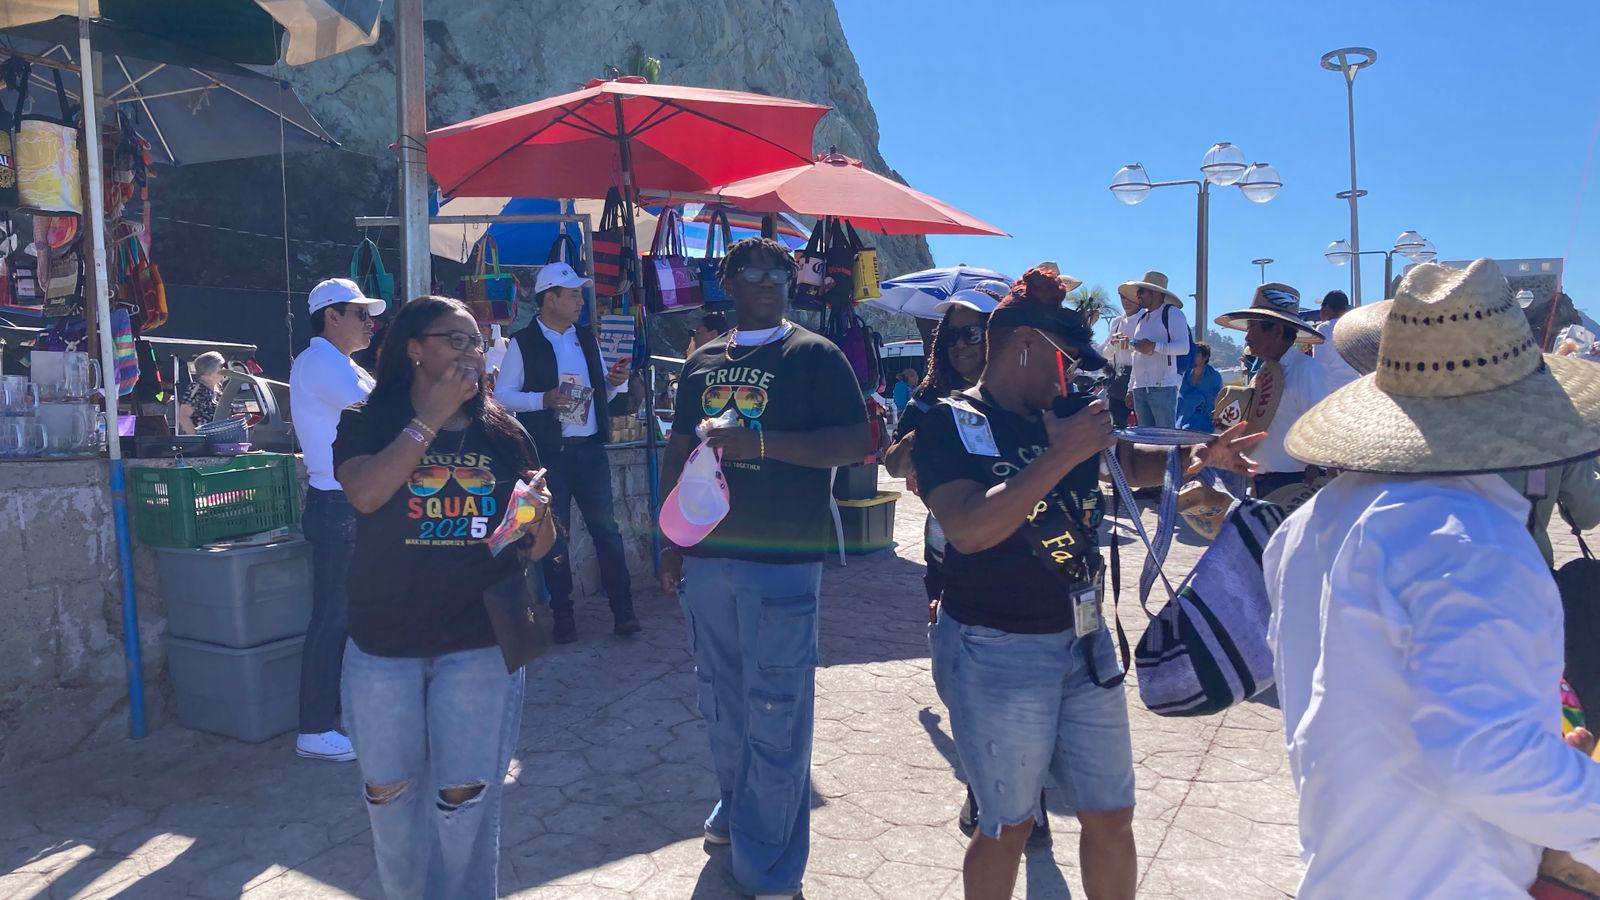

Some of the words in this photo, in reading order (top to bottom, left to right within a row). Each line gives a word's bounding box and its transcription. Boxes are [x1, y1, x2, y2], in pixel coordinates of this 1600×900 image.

[705, 367, 775, 389] CRUISE
[420, 453, 493, 471] RUISE
[733, 462, 760, 471] TOGETHER
[407, 495, 497, 519] SQUAD
[418, 516, 489, 539] 2025
[405, 538, 431, 546] MAKING
[432, 539, 465, 547] MEMORIES
